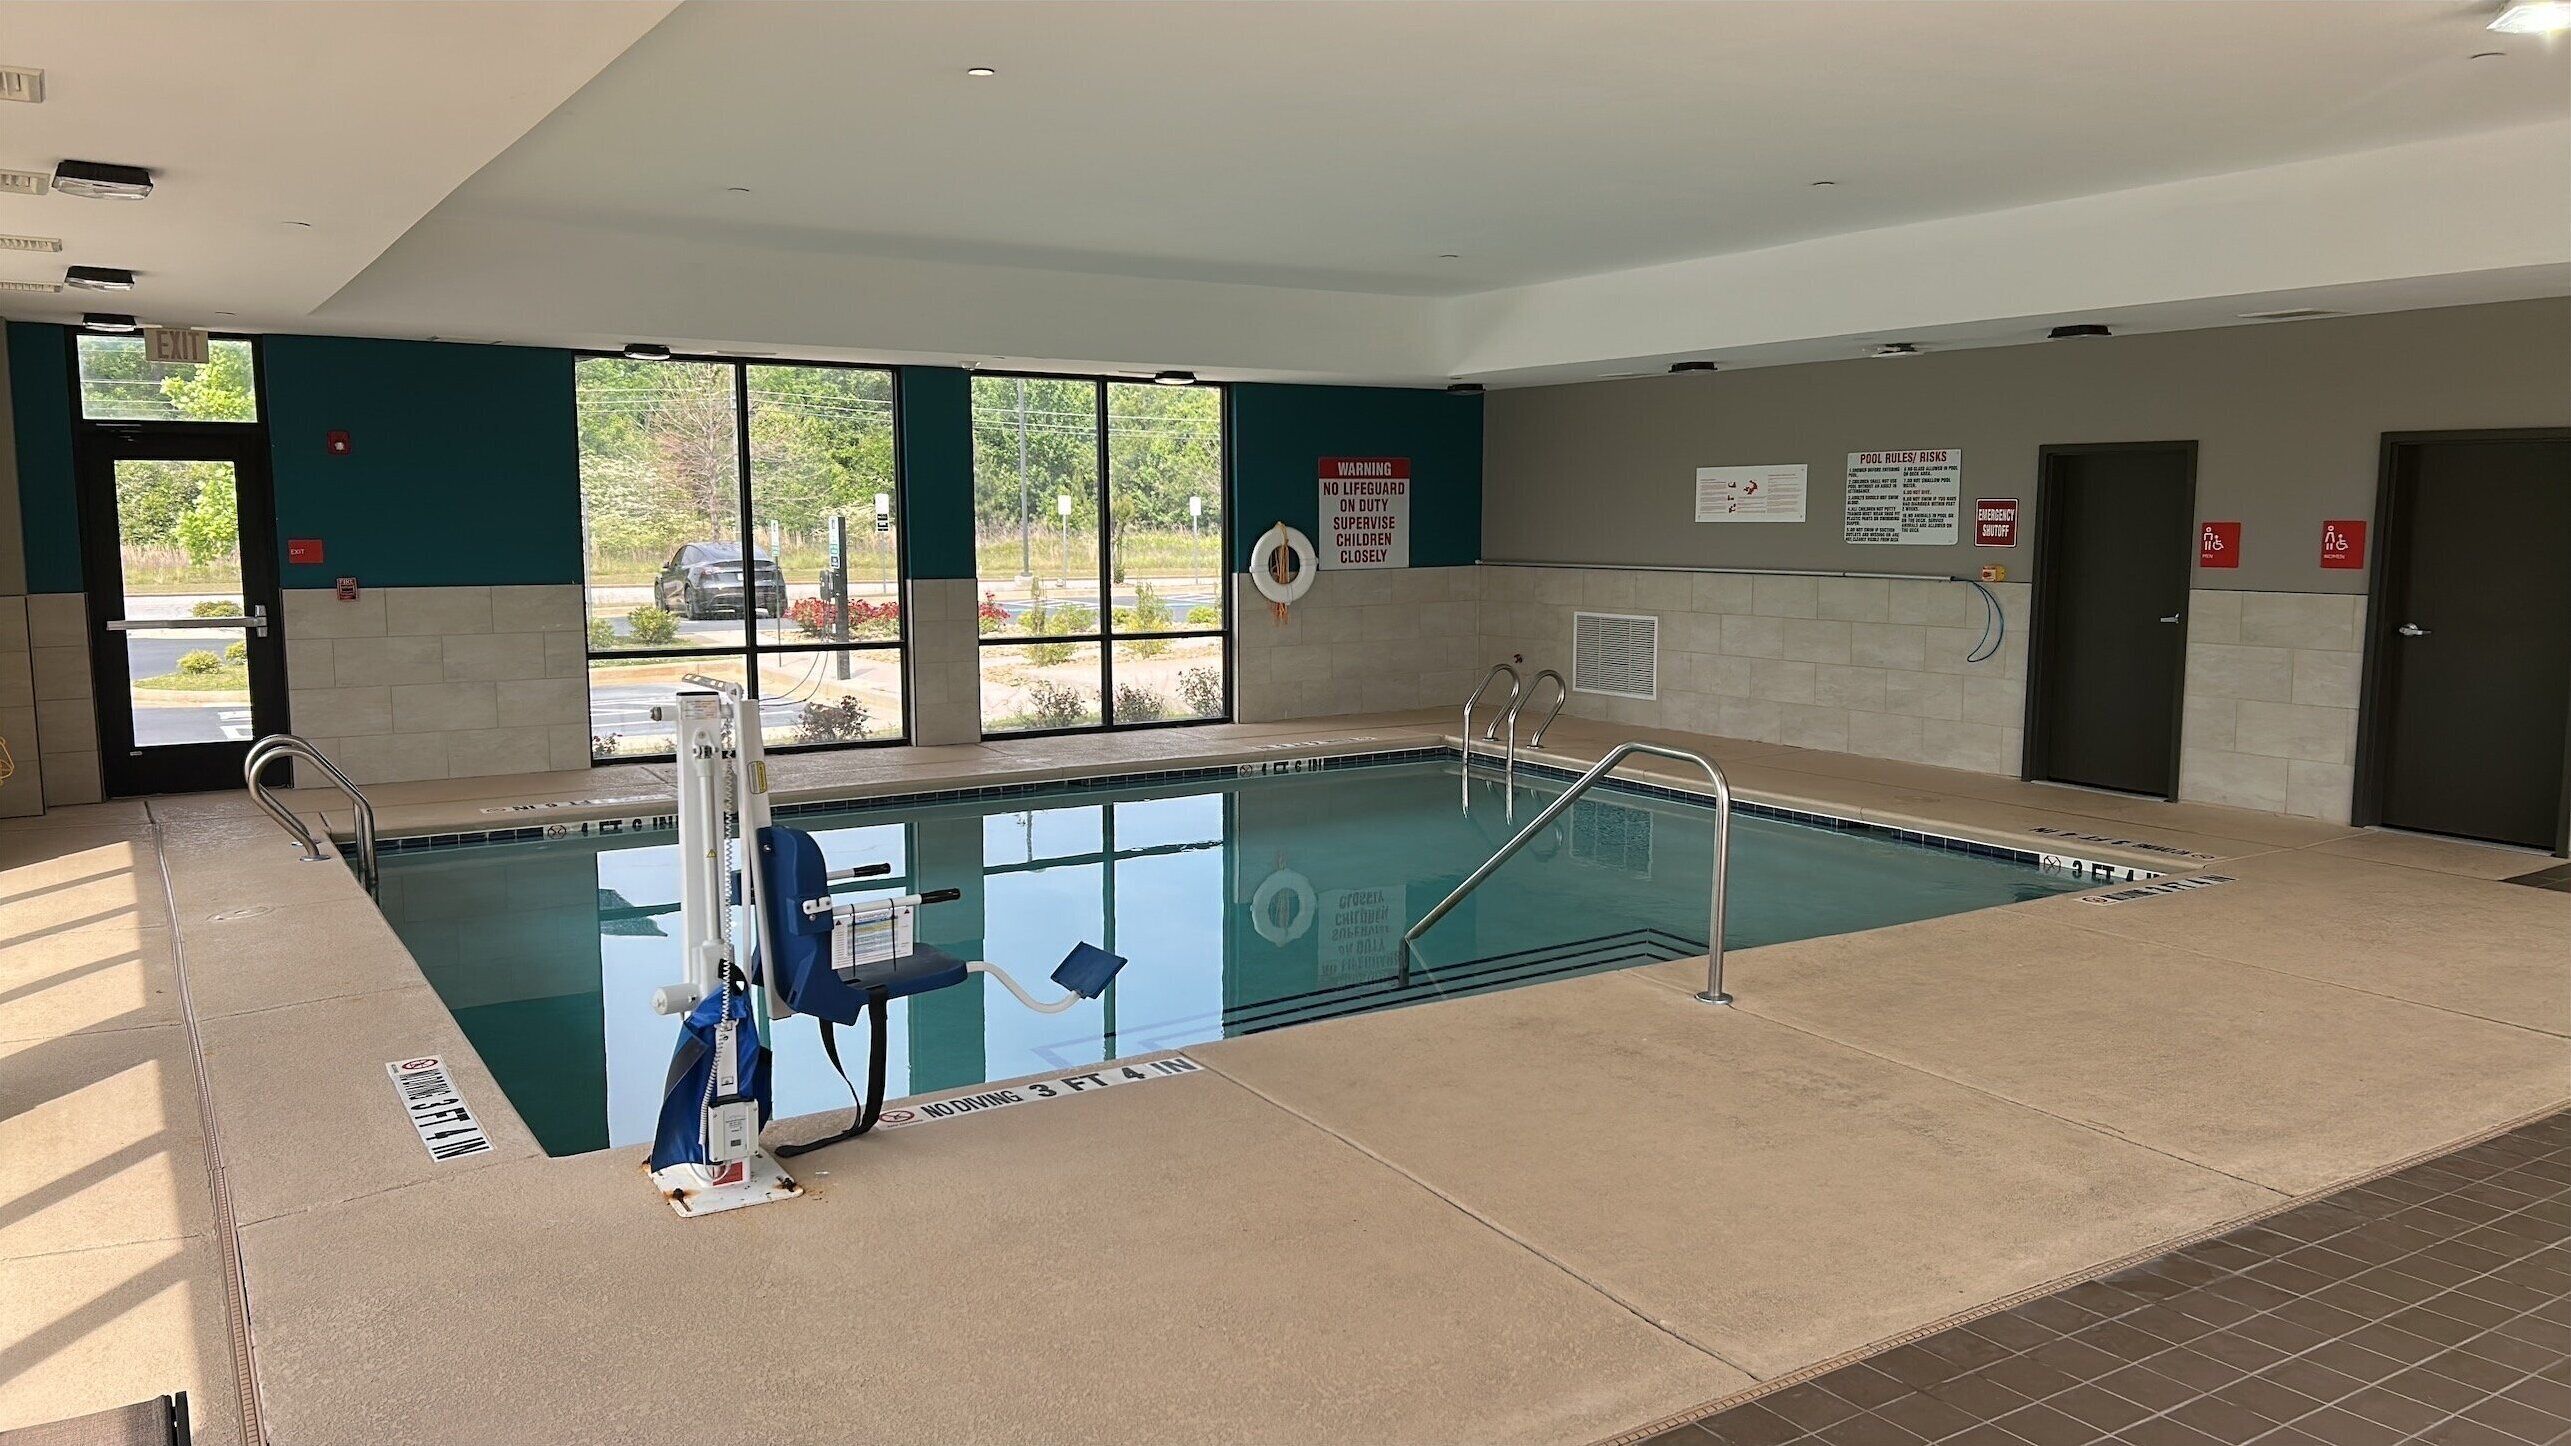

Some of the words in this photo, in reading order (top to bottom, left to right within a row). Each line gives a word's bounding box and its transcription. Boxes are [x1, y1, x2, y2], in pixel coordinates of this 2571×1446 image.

[156, 330, 199, 360] EXIT
[1861, 453, 1882, 464] POOL
[1885, 452, 1917, 463] RULES/
[1920, 451, 1947, 462] RISKS
[1338, 461, 1392, 477] WARNING
[1323, 482, 1339, 496] NO
[1343, 482, 1405, 496] LIFEGUARD
[1340, 499, 1355, 512] ON
[1359, 499, 1389, 512] DUTY
[1978, 508, 2015, 521] EMERGENCY
[1333, 516, 1395, 530] SUPERVISE
[1982, 524, 2010, 537] SHUTOFF
[1336, 532, 1392, 547] CHILDREN
[1340, 549, 1387, 563] CLOSELY
[2092, 863, 2115, 880] FT
[921, 1103, 955, 1118] NO
[955, 1090, 1024, 1112] DIVING
[1029, 1084, 1057, 1097] 3
[1061, 1073, 1107, 1091] FT
[1123, 1066, 1145, 1080] 4
[1151, 1058, 1196, 1075] IN
[410, 1098, 459, 1110] 3
[414, 1107, 470, 1128] FT
[426, 1127, 478, 1141] 4
[432, 1137, 490, 1160] IN
